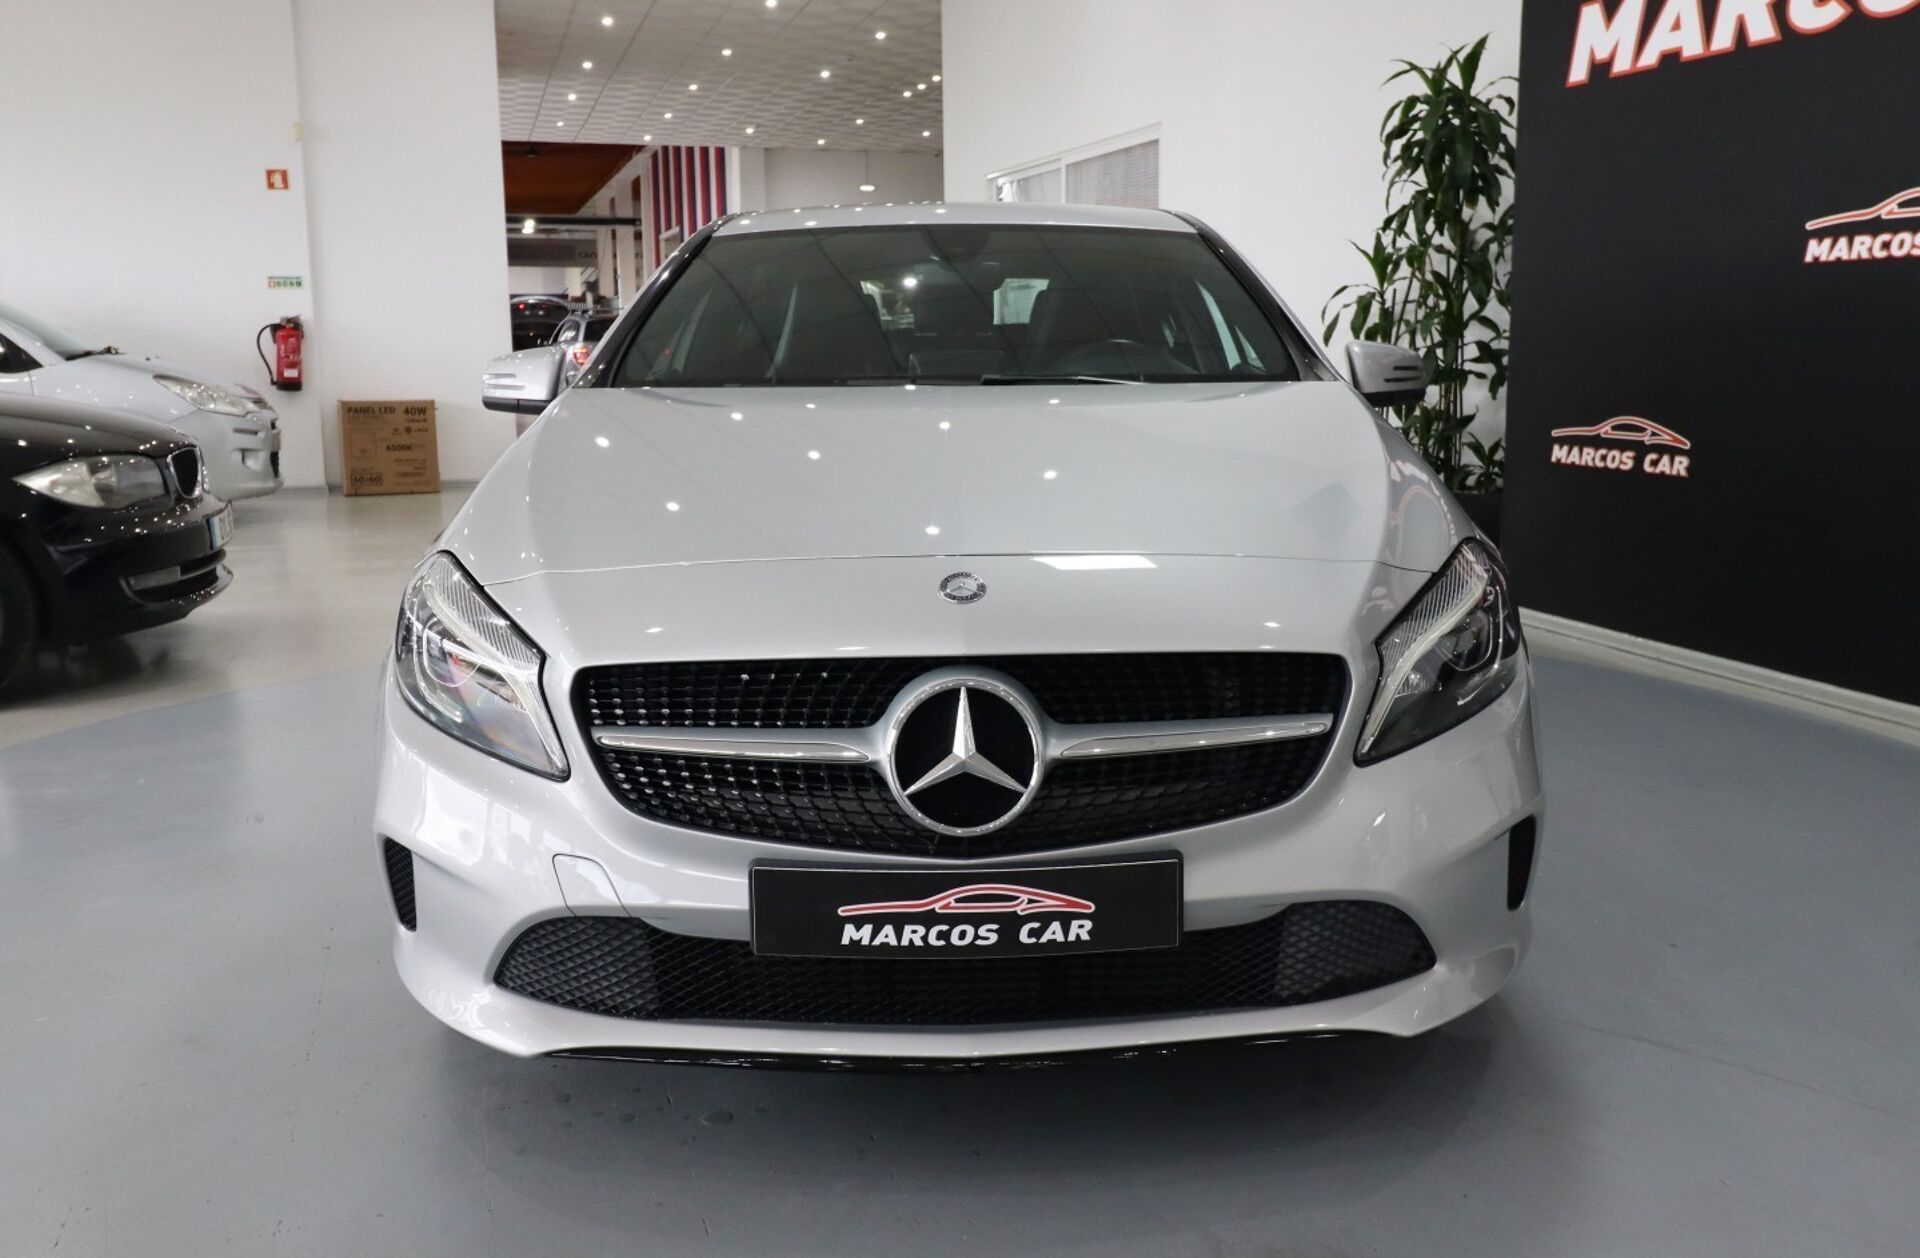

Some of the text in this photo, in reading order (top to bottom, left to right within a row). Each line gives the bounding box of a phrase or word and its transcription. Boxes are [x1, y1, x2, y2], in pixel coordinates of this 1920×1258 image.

[347, 406, 427, 416] PANEL LED 40W
[1551, 444, 1690, 477] MARCOS CAR
[841, 919, 1093, 946] MARCOS CAR
